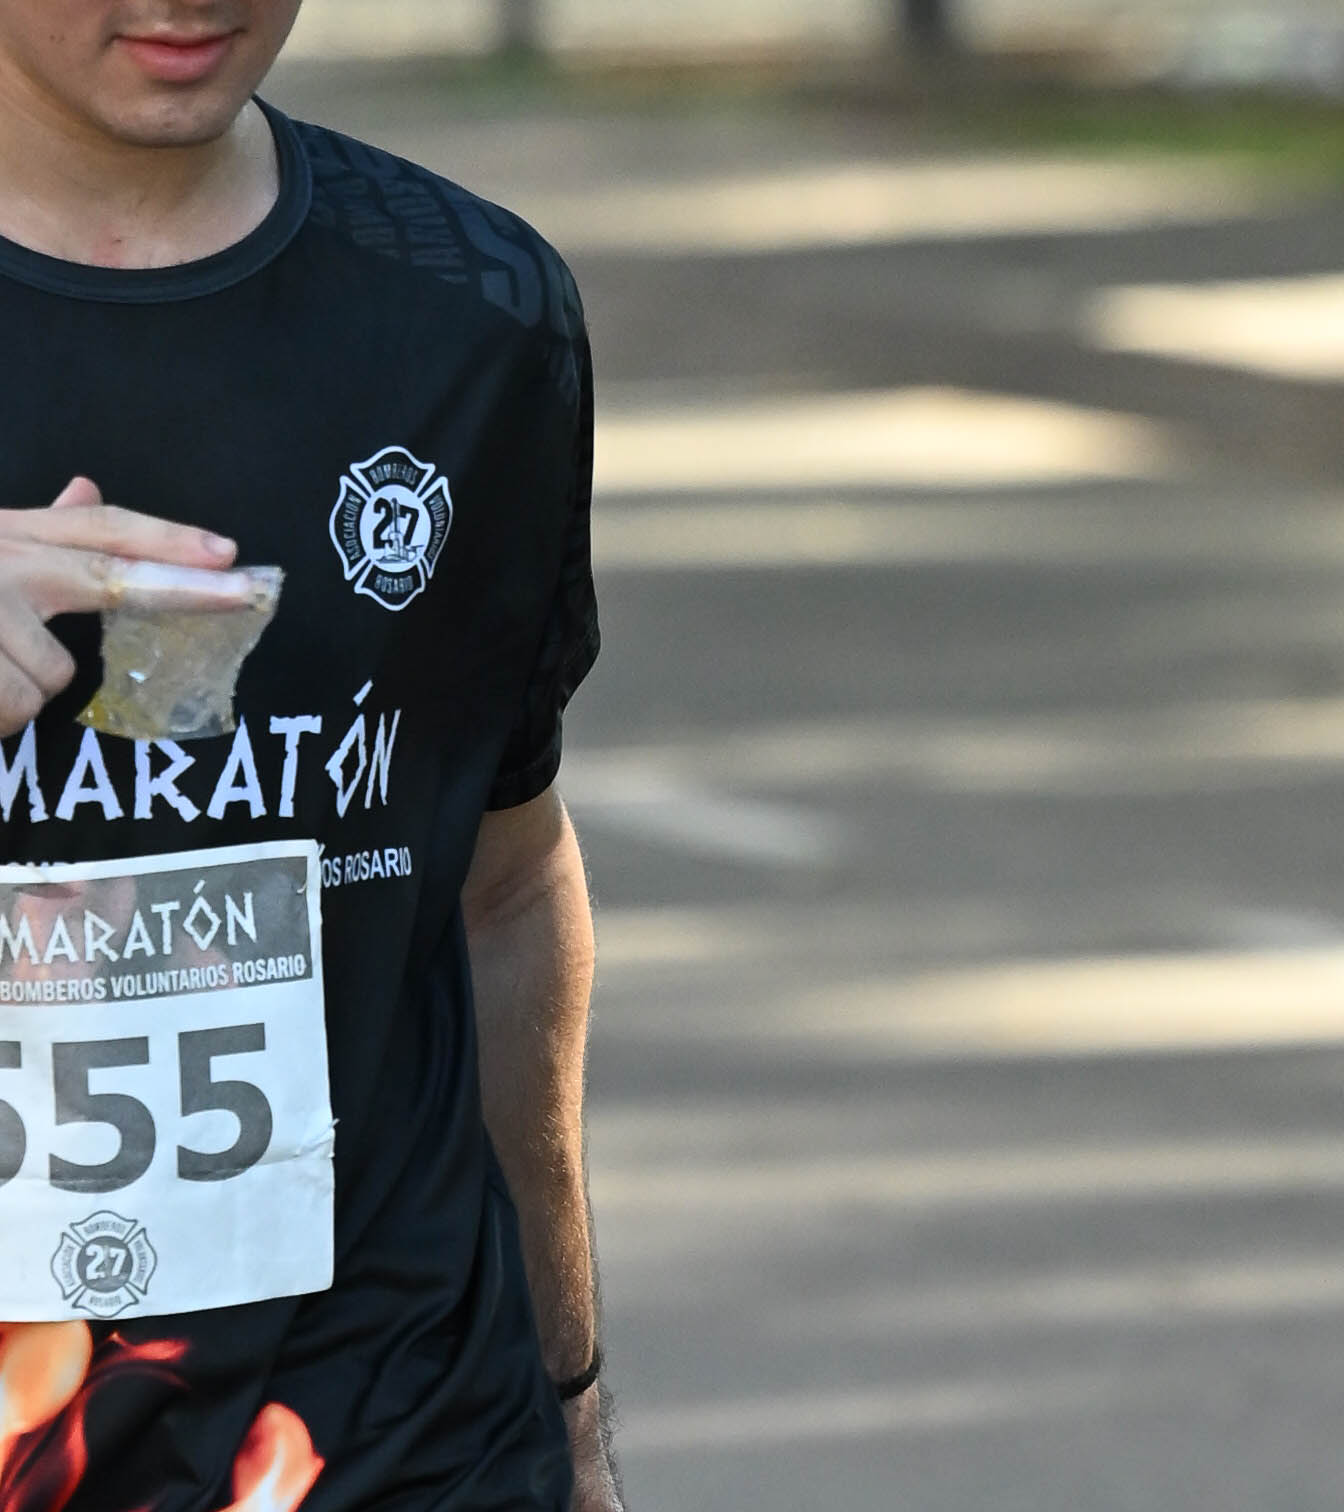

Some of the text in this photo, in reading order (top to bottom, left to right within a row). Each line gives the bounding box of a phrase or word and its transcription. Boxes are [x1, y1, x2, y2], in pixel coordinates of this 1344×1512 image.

[372, 496, 420, 550] 27
[344, 845, 412, 886] ROSARIO
[0, 953, 307, 1003] BOMBEROS VOLUNTARIOS ROSARIO
[85, 1243, 127, 1281] 27
